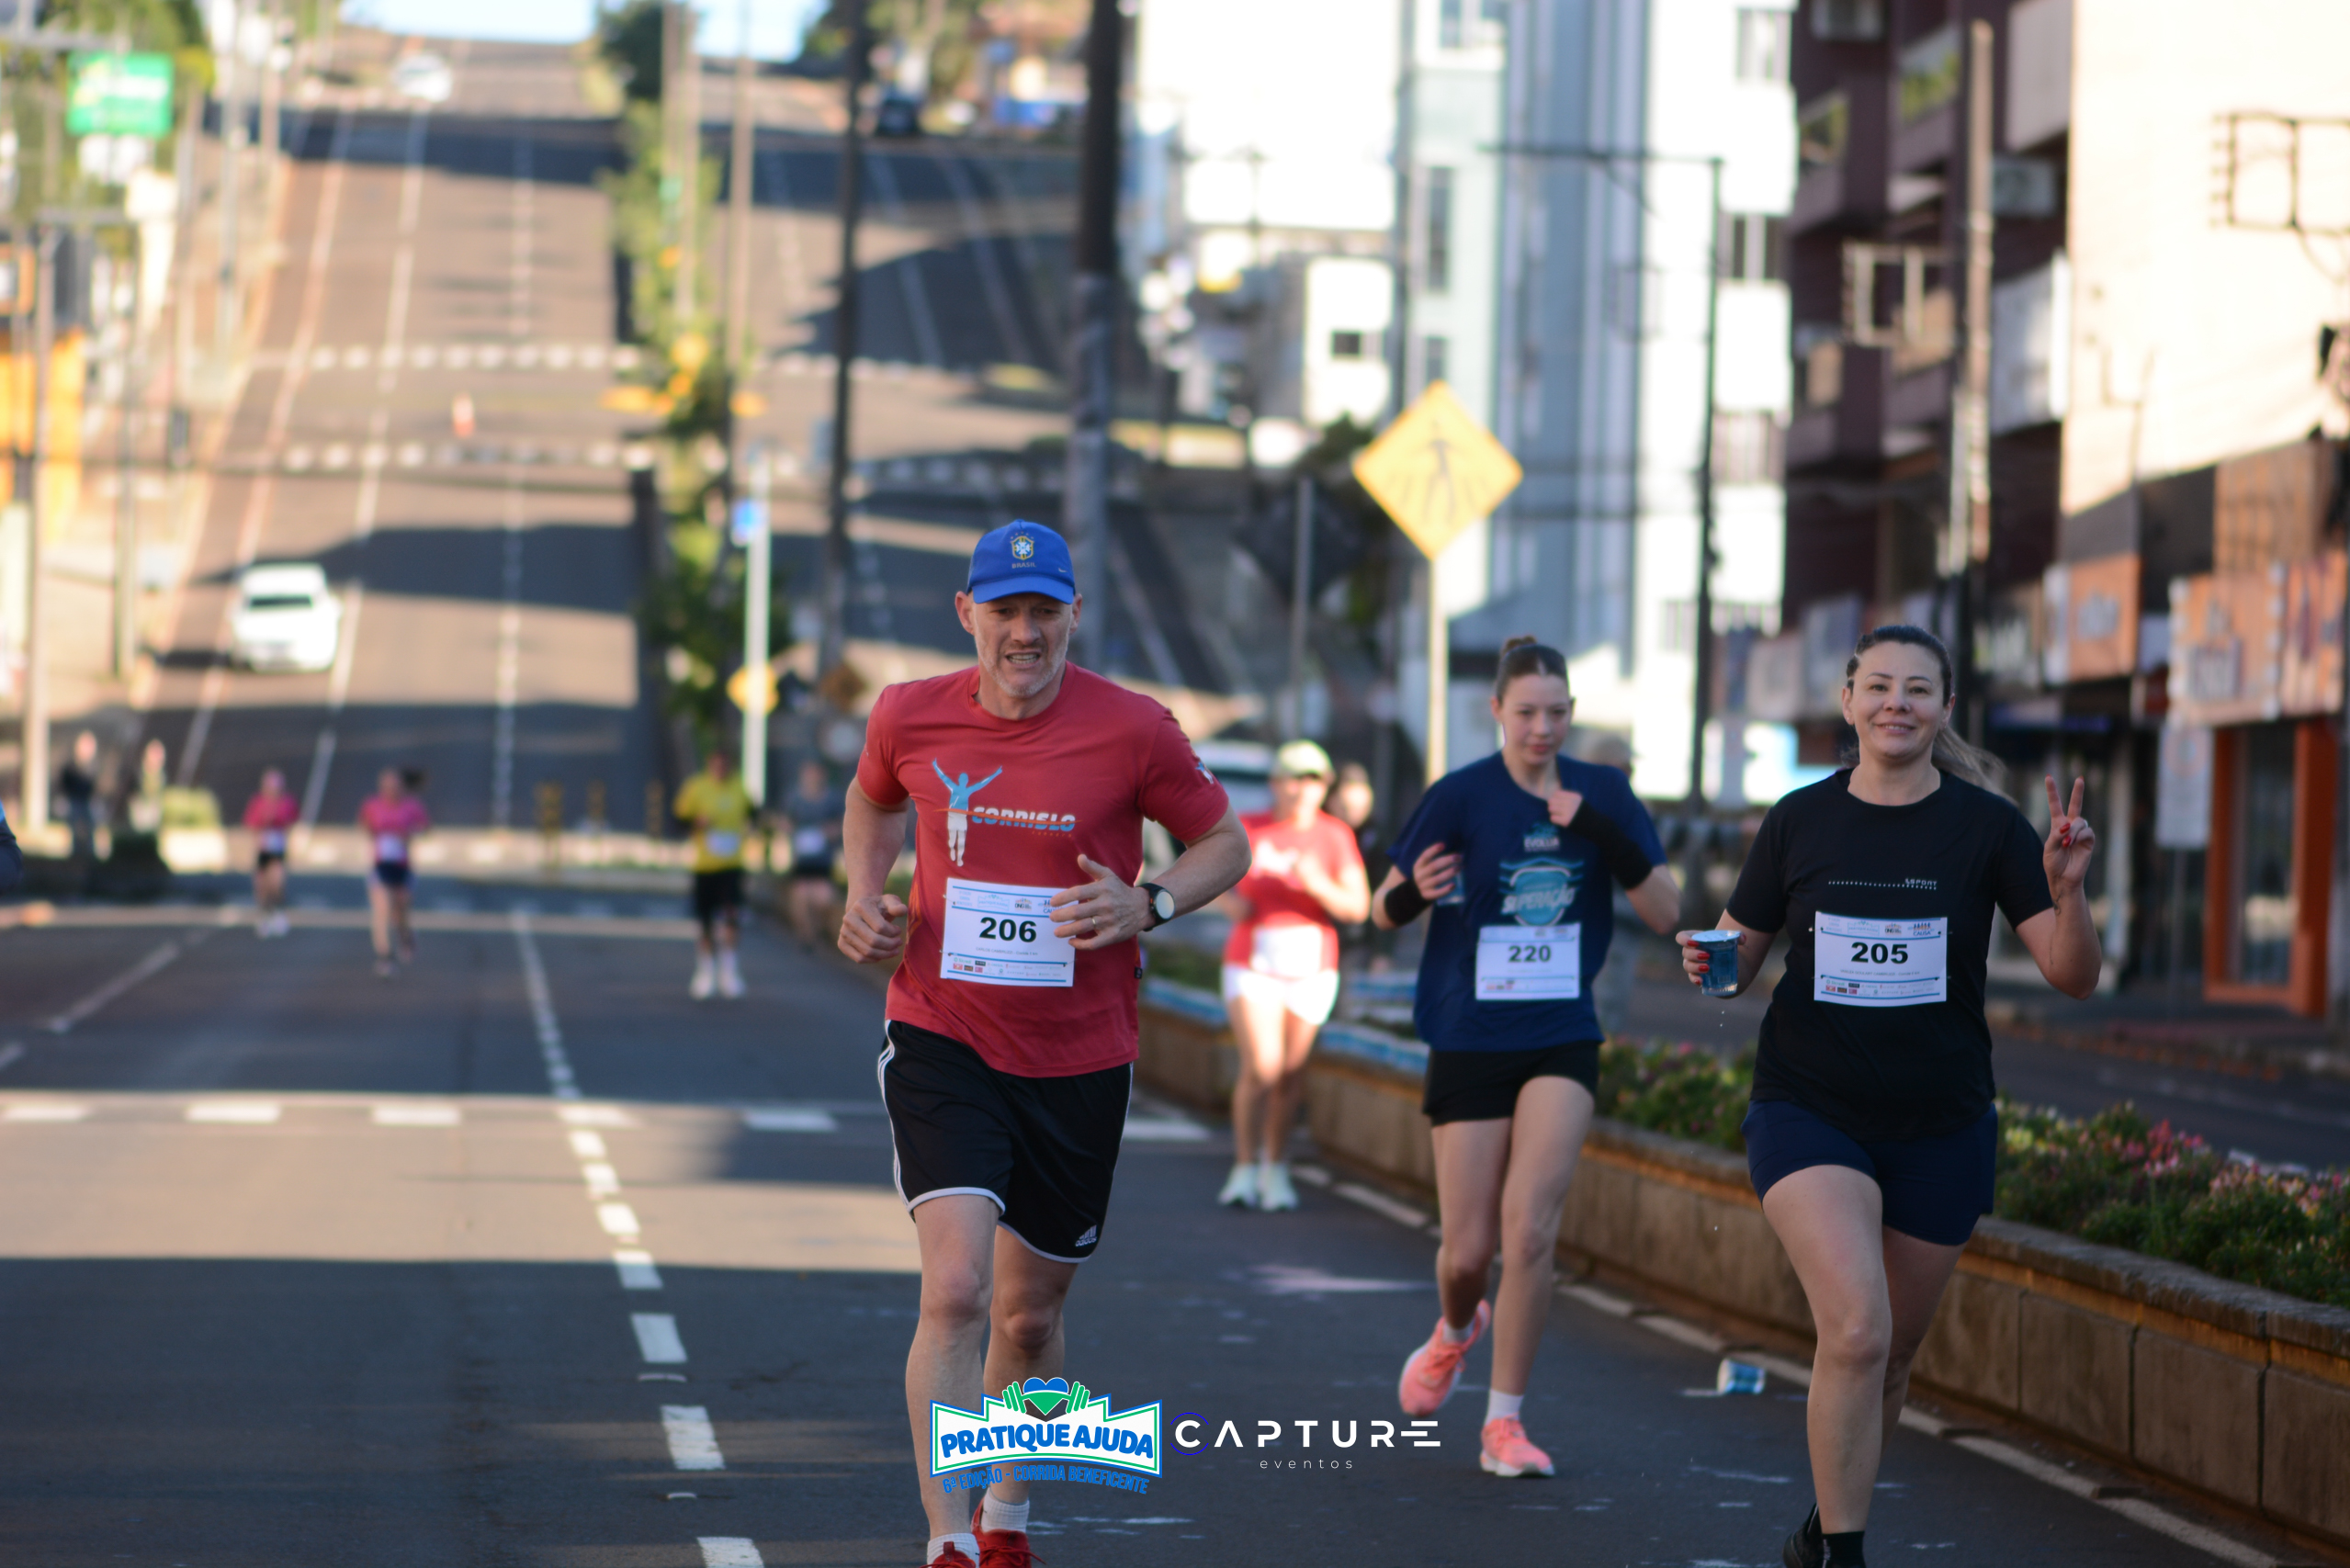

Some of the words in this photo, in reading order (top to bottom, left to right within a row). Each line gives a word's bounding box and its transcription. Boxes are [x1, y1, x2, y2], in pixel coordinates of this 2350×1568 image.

[979, 916, 1037, 942] 206
[1508, 944, 1552, 963] 220
[1850, 942, 1909, 964] 205
[1075, 1236, 1097, 1247] adidas
